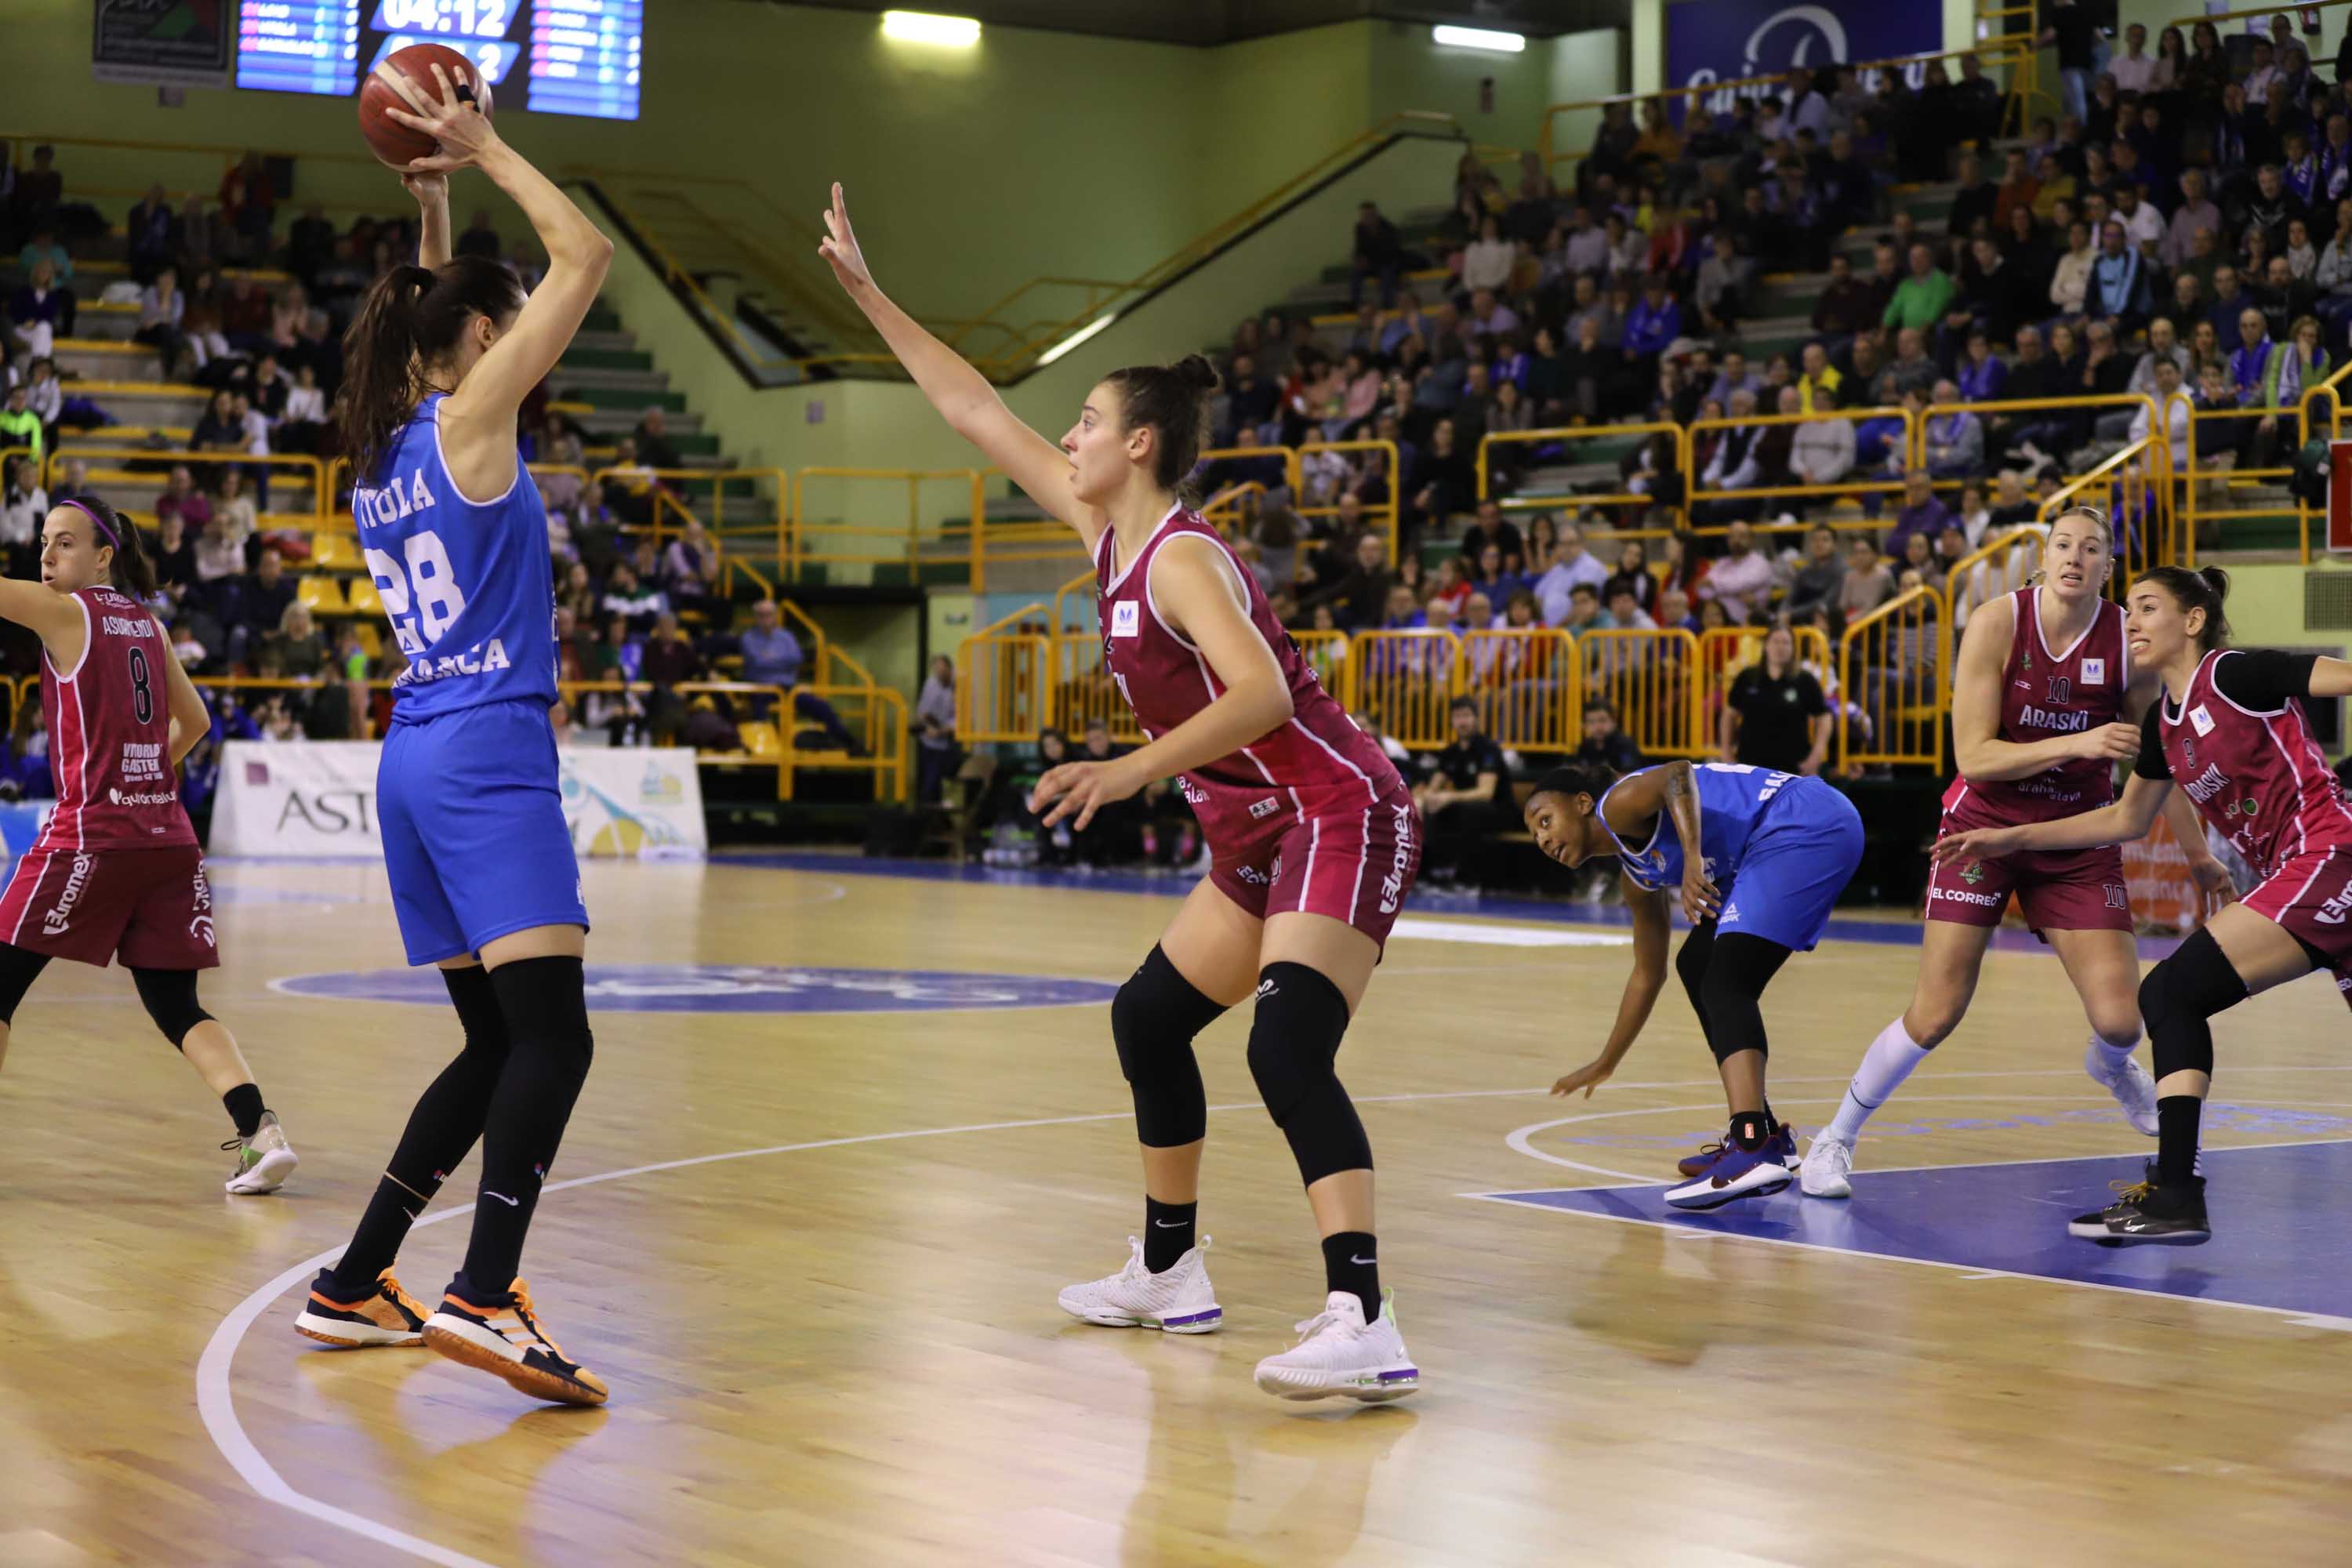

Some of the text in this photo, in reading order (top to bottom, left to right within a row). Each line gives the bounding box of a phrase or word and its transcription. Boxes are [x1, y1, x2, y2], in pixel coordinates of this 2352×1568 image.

[383, 0, 506, 38] 04:12
[364, 530, 466, 655] 28
[128, 646, 154, 724] 8
[2045, 676, 2070, 705] 10
[44, 850, 94, 922] Euromex
[1381, 804, 1410, 904] Euromex
[1932, 887, 1944, 900] EL
